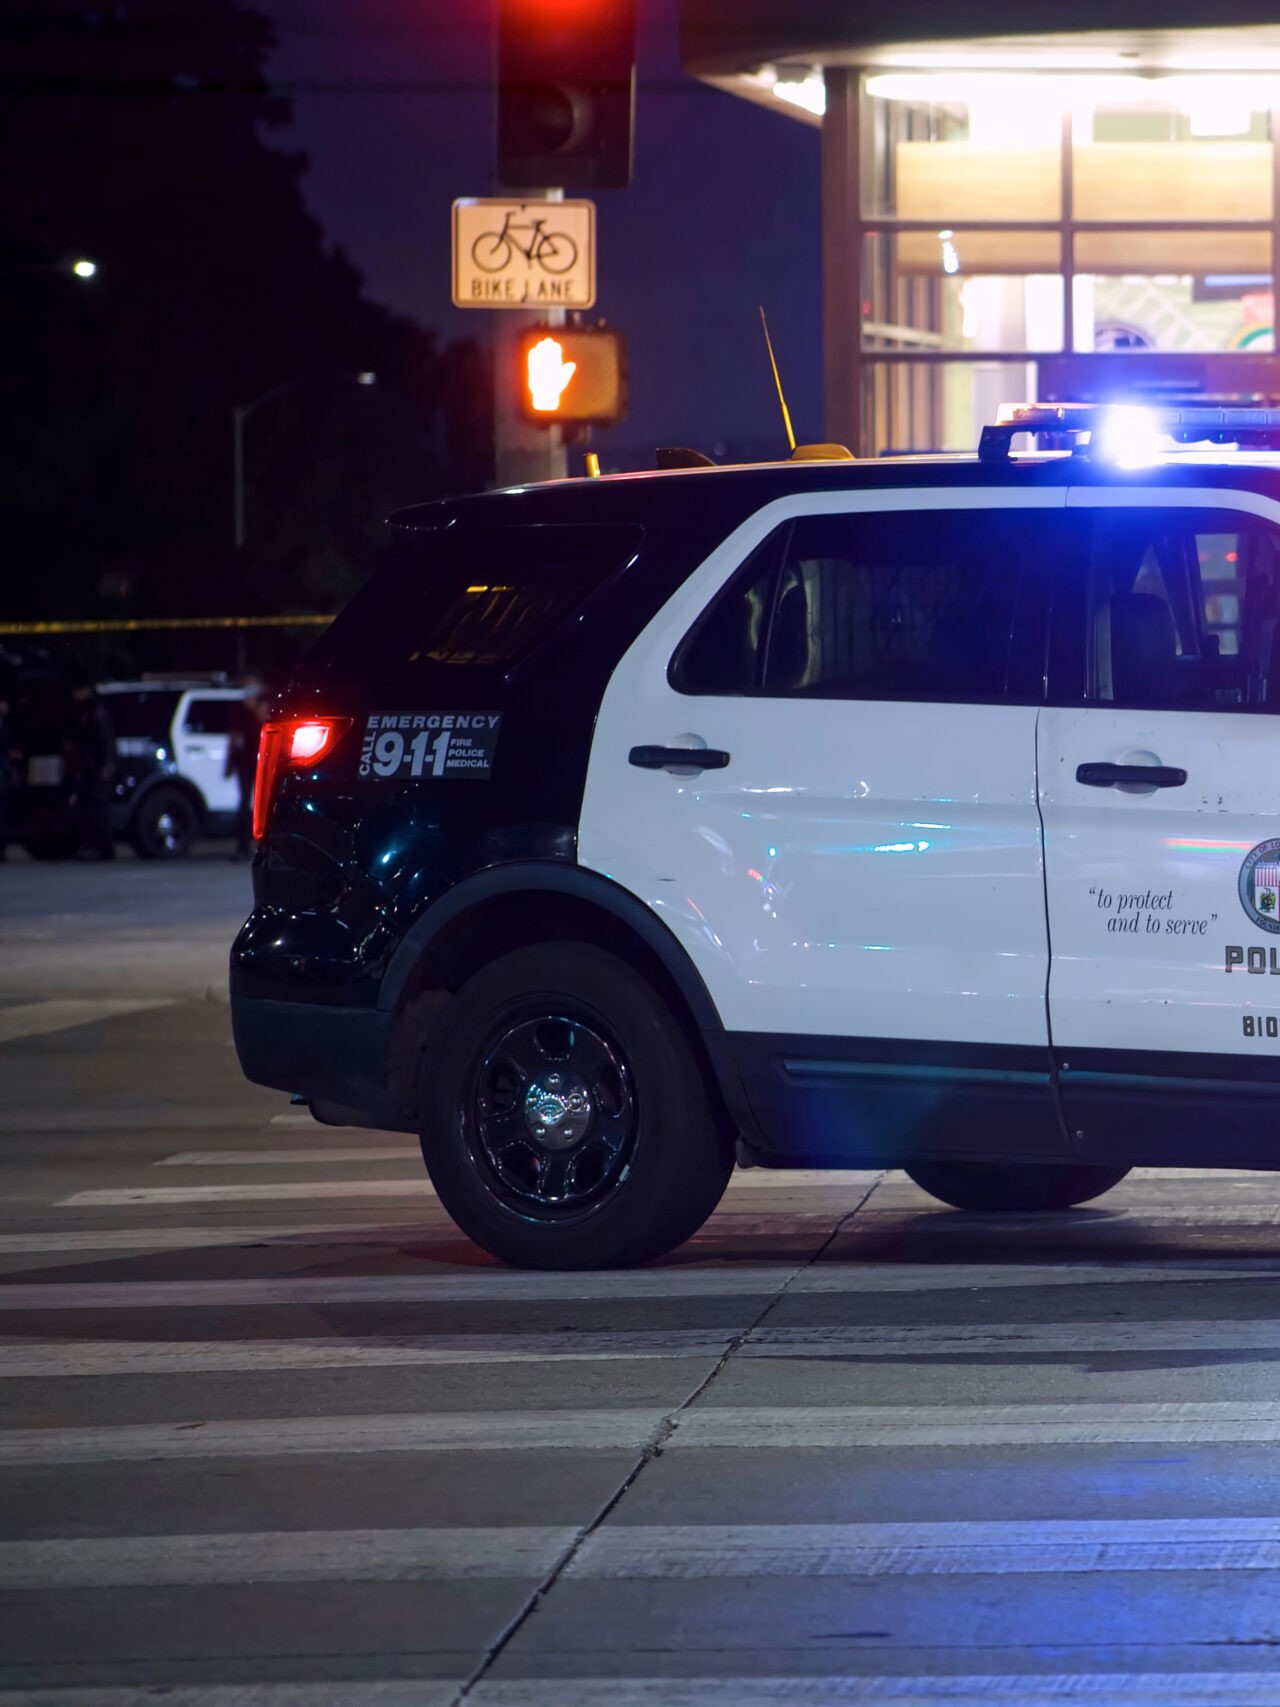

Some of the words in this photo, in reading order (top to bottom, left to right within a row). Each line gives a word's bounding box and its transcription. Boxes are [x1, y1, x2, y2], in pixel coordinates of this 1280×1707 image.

[471, 279, 513, 297] BIKE
[523, 280, 574, 298] LANE
[367, 715, 500, 729] EMERGENCY
[450, 738, 473, 747] FIRE
[359, 731, 377, 776] CALL
[373, 731, 451, 776] 9-1-1
[447, 749, 485, 757] POLICE
[446, 759, 490, 768] MEDICAL
[1259, 843, 1267, 853] OF
[1117, 889, 1174, 914] protect
[1107, 911, 1139, 934] and
[1146, 914, 1161, 934] to
